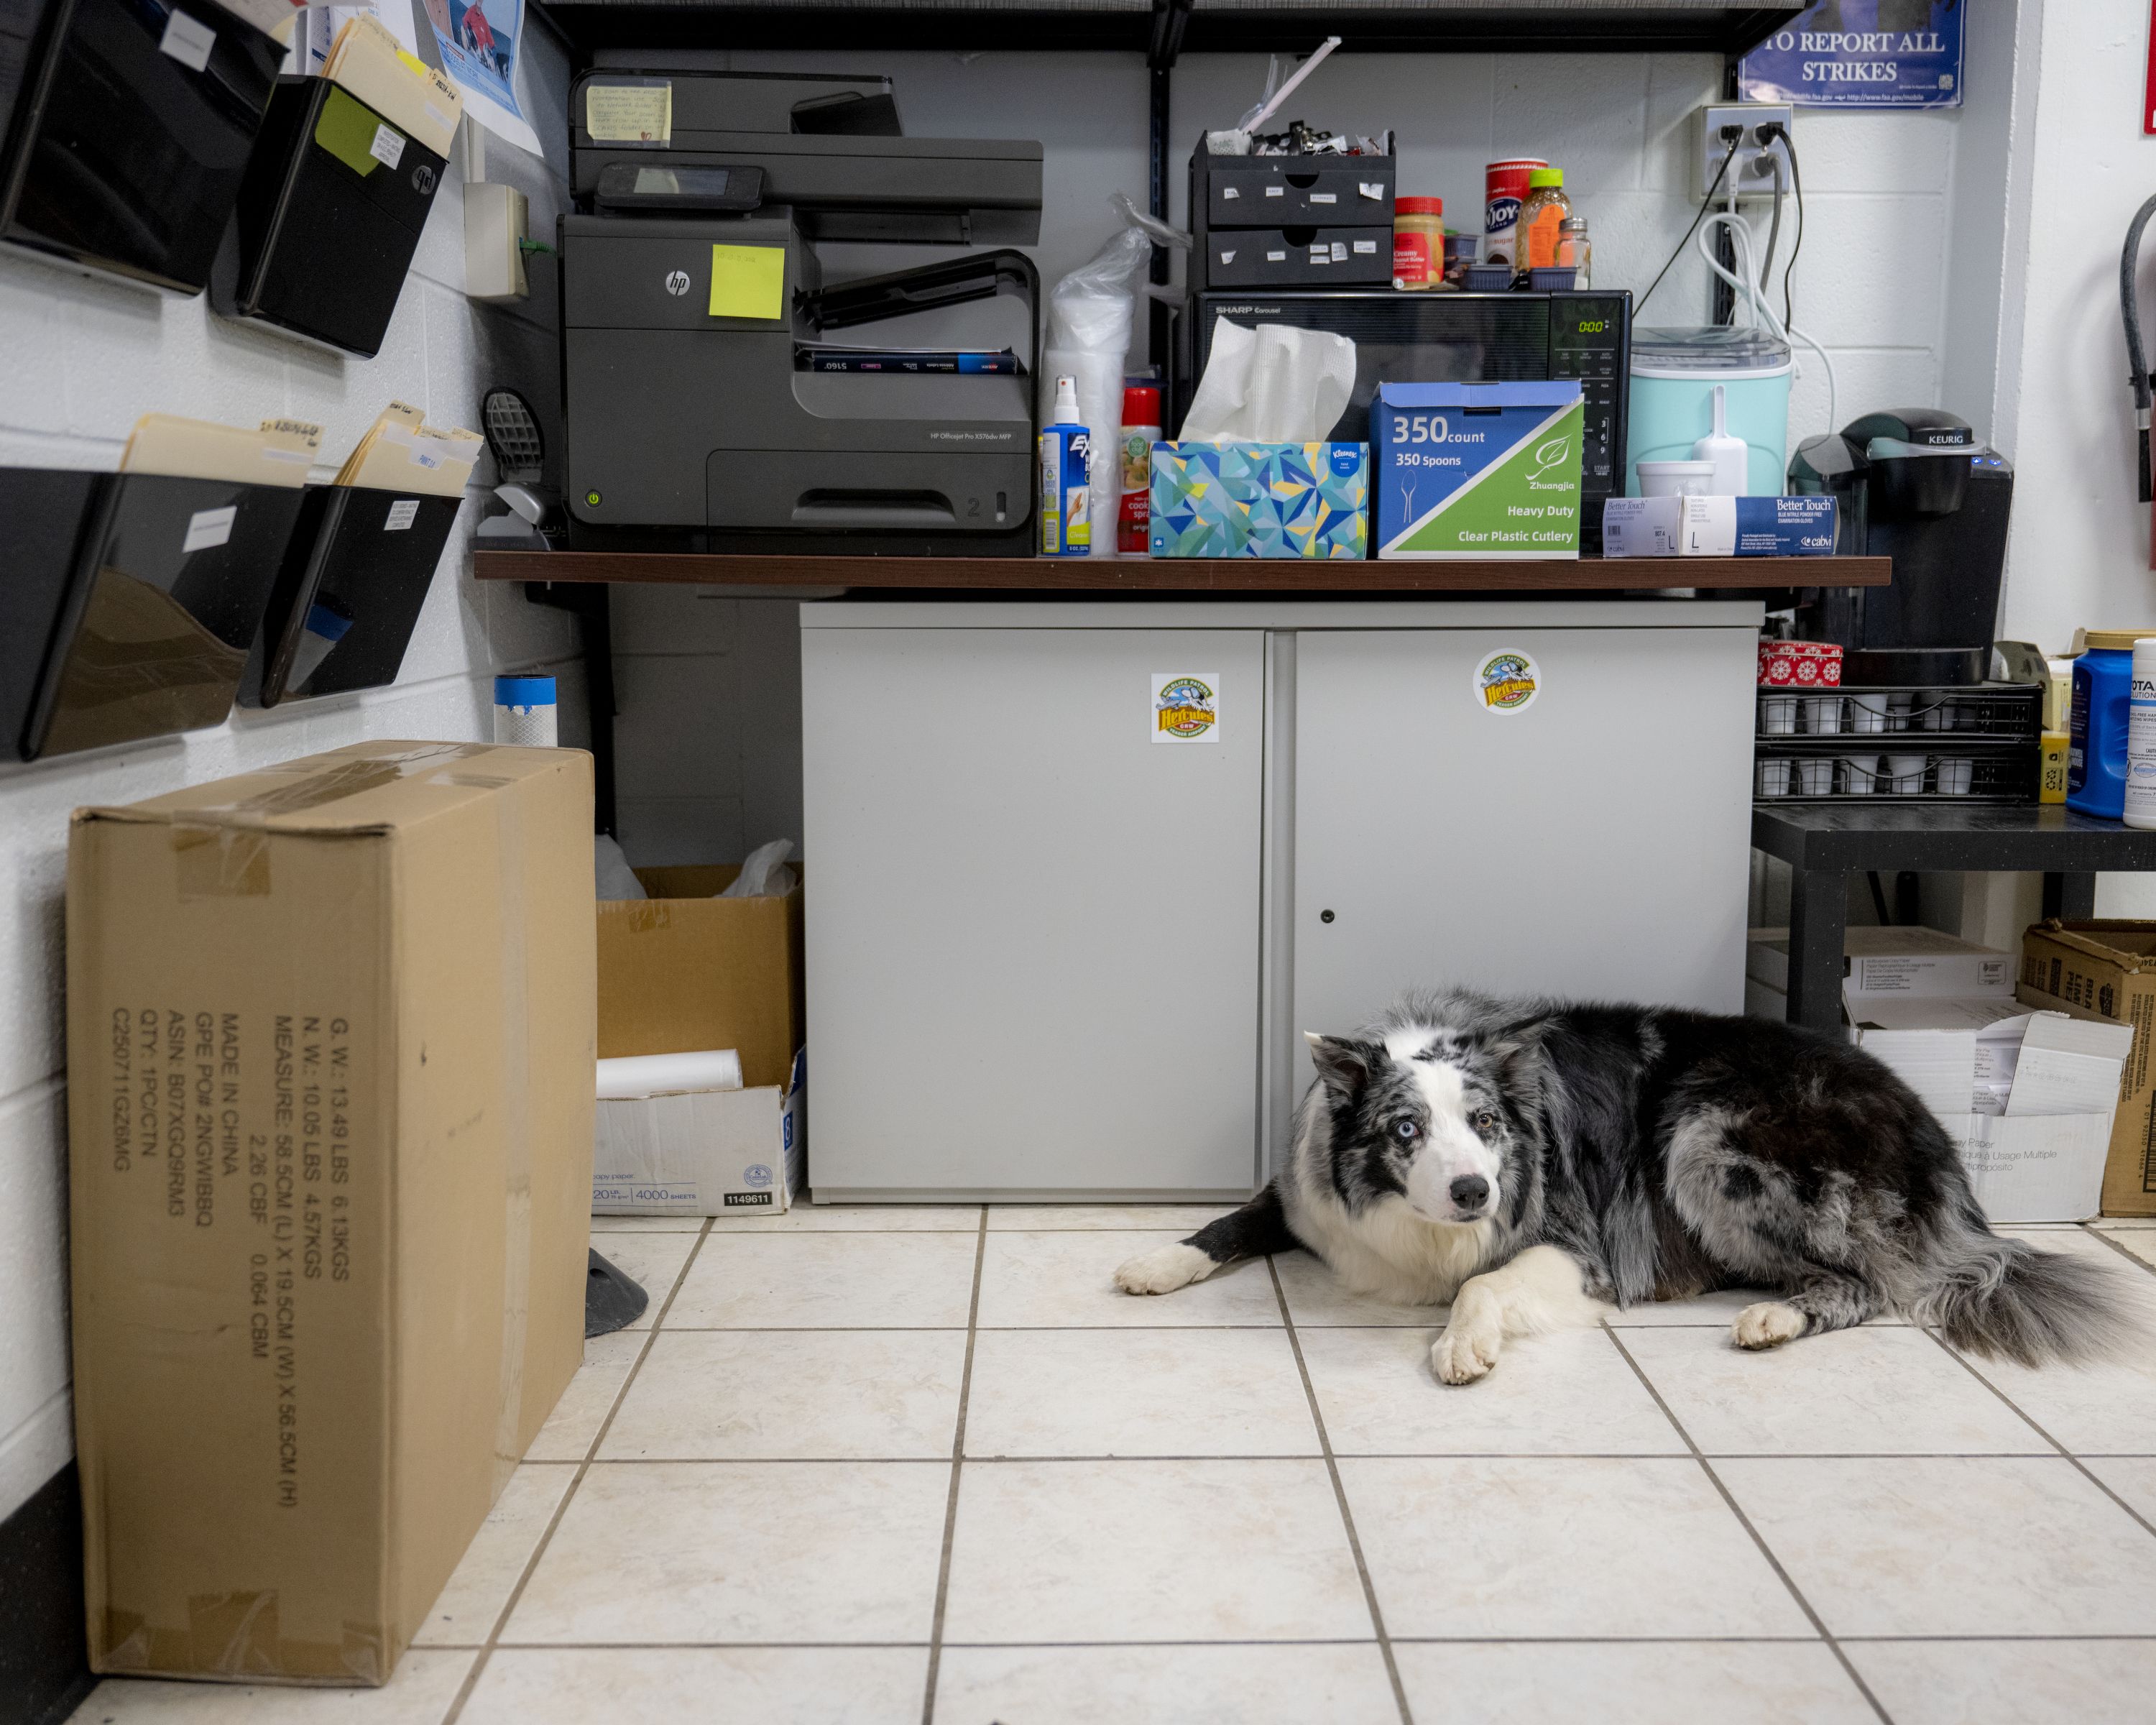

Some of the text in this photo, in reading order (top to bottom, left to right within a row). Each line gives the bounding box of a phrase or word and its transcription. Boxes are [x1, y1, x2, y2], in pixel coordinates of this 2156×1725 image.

[1799, 32, 1894, 52] REPORT
[1897, 33, 1945, 52] ALL
[1802, 61, 1897, 82] STRIKES
[1579, 321, 1603, 333] 0:00
[1392, 417, 1485, 443] 350 count
[1929, 435, 1963, 444] KEURIG
[1069, 435, 1089, 458] EX
[1332, 449, 1358, 459] Kleenex
[1396, 454, 1461, 468] 350 Spoons
[1529, 482, 1575, 492] Zhuangjia
[967, 497, 980, 517] 2
[1133, 510, 1150, 519] spra
[1508, 506, 1575, 518] Heavy Duty
[1608, 501, 1645, 510] Better Touch
[1777, 499, 1830, 511] Better Touch
[1458, 530, 1573, 543] Clear Plastic Cutlery
[1668, 535, 1674, 549] L
[1691, 532, 1700, 548] L
[1811, 535, 1832, 547] cabvi
[1484, 656, 1526, 675] WILDLIFE PATROL
[1162, 679, 1210, 696] WILDLIFE PATROL
[1487, 681, 1534, 705] Hercules
[2132, 680, 2155, 691] OTA
[1161, 709, 1213, 730] Hercules
[1169, 724, 1206, 737] YEAGER AIRPORT
[2085, 978, 2094, 1009] BRA
[195, 1011, 213, 1057] GPE
[303, 1016, 321, 1036] N.
[330, 1018, 349, 1041] G.
[167, 1009, 185, 1066] ASIN:
[139, 1009, 158, 1156] QTY: 1PC/CTN
[195, 1064, 213, 1107] PO#
[221, 1013, 239, 1177] MADE IN CHINA
[303, 1083, 321, 1137] 10.05
[331, 1087, 349, 1141] 13.49
[1968, 1138, 1994, 1149] Paper
[303, 1140, 321, 1182] LBS
[331, 1144, 349, 1184] LBS
[1984, 1151, 1990, 1160] à
[1993, 1152, 2021, 1161] Usage
[2024, 1150, 2057, 1159] Multiple
[594, 1190, 609, 1199] 20
[636, 1190, 668, 1200] 4000
[727, 1195, 768, 1204] 1149611
[249, 1133, 269, 1358] 2.26 CBF 0.064 CBM
[303, 1192, 322, 1281] 4.57KGS
[331, 1195, 350, 1282] 6.13KGS
[272, 1015, 298, 1508] MEASURE: 58.5CM (L) X 19.5CM (W) X 56.5CM (H)
